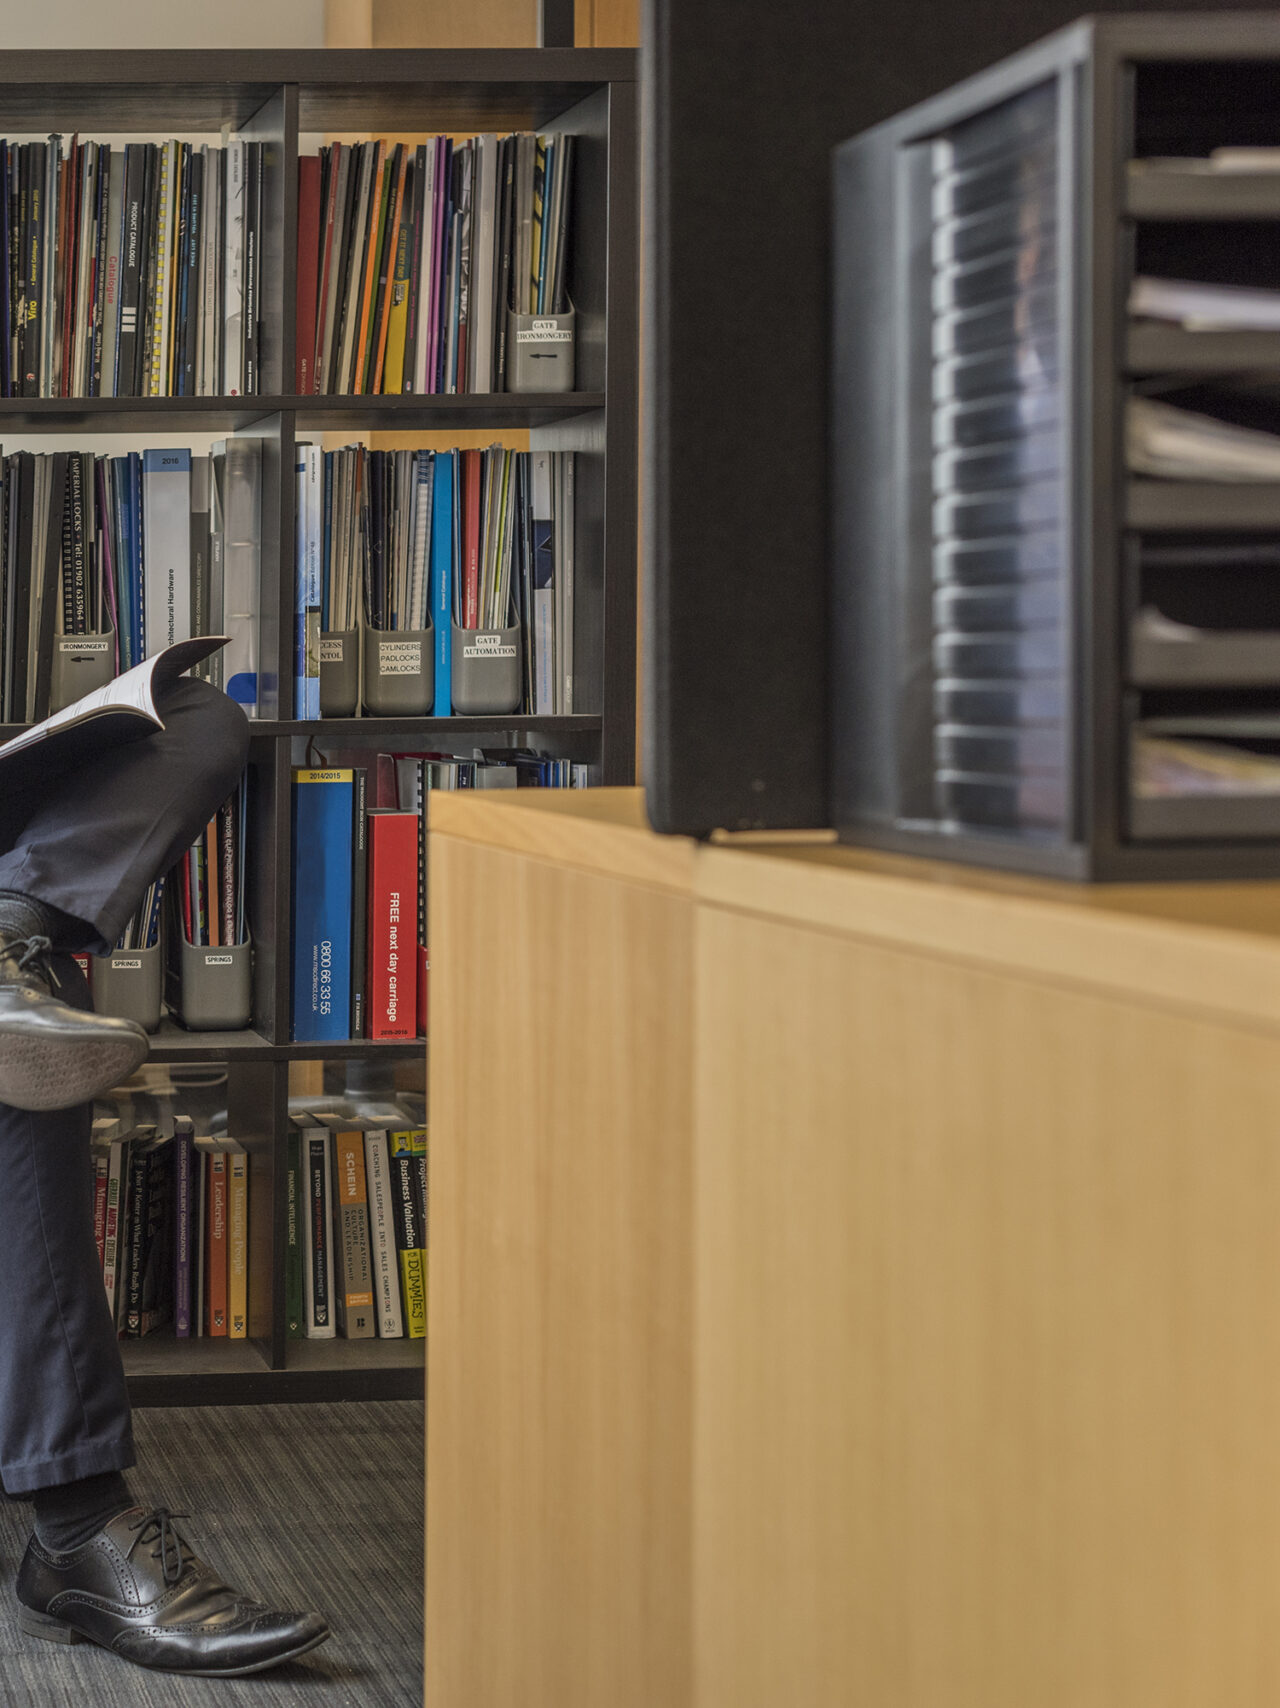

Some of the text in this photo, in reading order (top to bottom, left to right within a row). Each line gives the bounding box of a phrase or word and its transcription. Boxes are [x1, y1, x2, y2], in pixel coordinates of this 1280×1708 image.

[128, 201, 138, 267] PRODUCT CATALOGUE
[399, 228, 407, 240] GET
[398, 249, 406, 262] NEXT
[106, 256, 117, 304] Catalogue
[27, 301, 38, 320] Viro
[72, 458, 80, 498] IMPERIAL
[74, 502, 82, 532] LOCKS
[75, 560, 83, 586] 01902
[76, 588, 84, 620] 635964
[380, 654, 420, 662] PADLOCKS
[464, 647, 516, 655] AUTOMATION
[310, 772, 341, 780] 2014/2015
[320, 940, 332, 1014] 0800 66 33 55
[386, 892, 400, 1022] FREE next day carriage
[346, 1152, 356, 1196] SCHEIN
[372, 1144, 380, 1178] COACHING
[418, 1158, 427, 1188] Project
[314, 1170, 322, 1198] BEYOND
[375, 1182, 384, 1226] SALESPEOPLE
[400, 1160, 416, 1248] Business Valuation
[94, 1187, 106, 1237] Managing
[213, 1182, 224, 1238] Leadership
[288, 1203, 296, 1246] INTELLIGENCE
[350, 1210, 358, 1246] CULTURE
[106, 1207, 118, 1267] MARKETING EXCELLENCE
[131, 1170, 144, 1304] John Kotter What Leaders Really Do
[234, 1186, 244, 1275] Managing People
[358, 1209, 368, 1281] ORGANIZATIONAL
[380, 1251, 388, 1272] SALES
[382, 1275, 391, 1312] CHAMPIONS
[407, 1260, 424, 1320] DUMMIES
